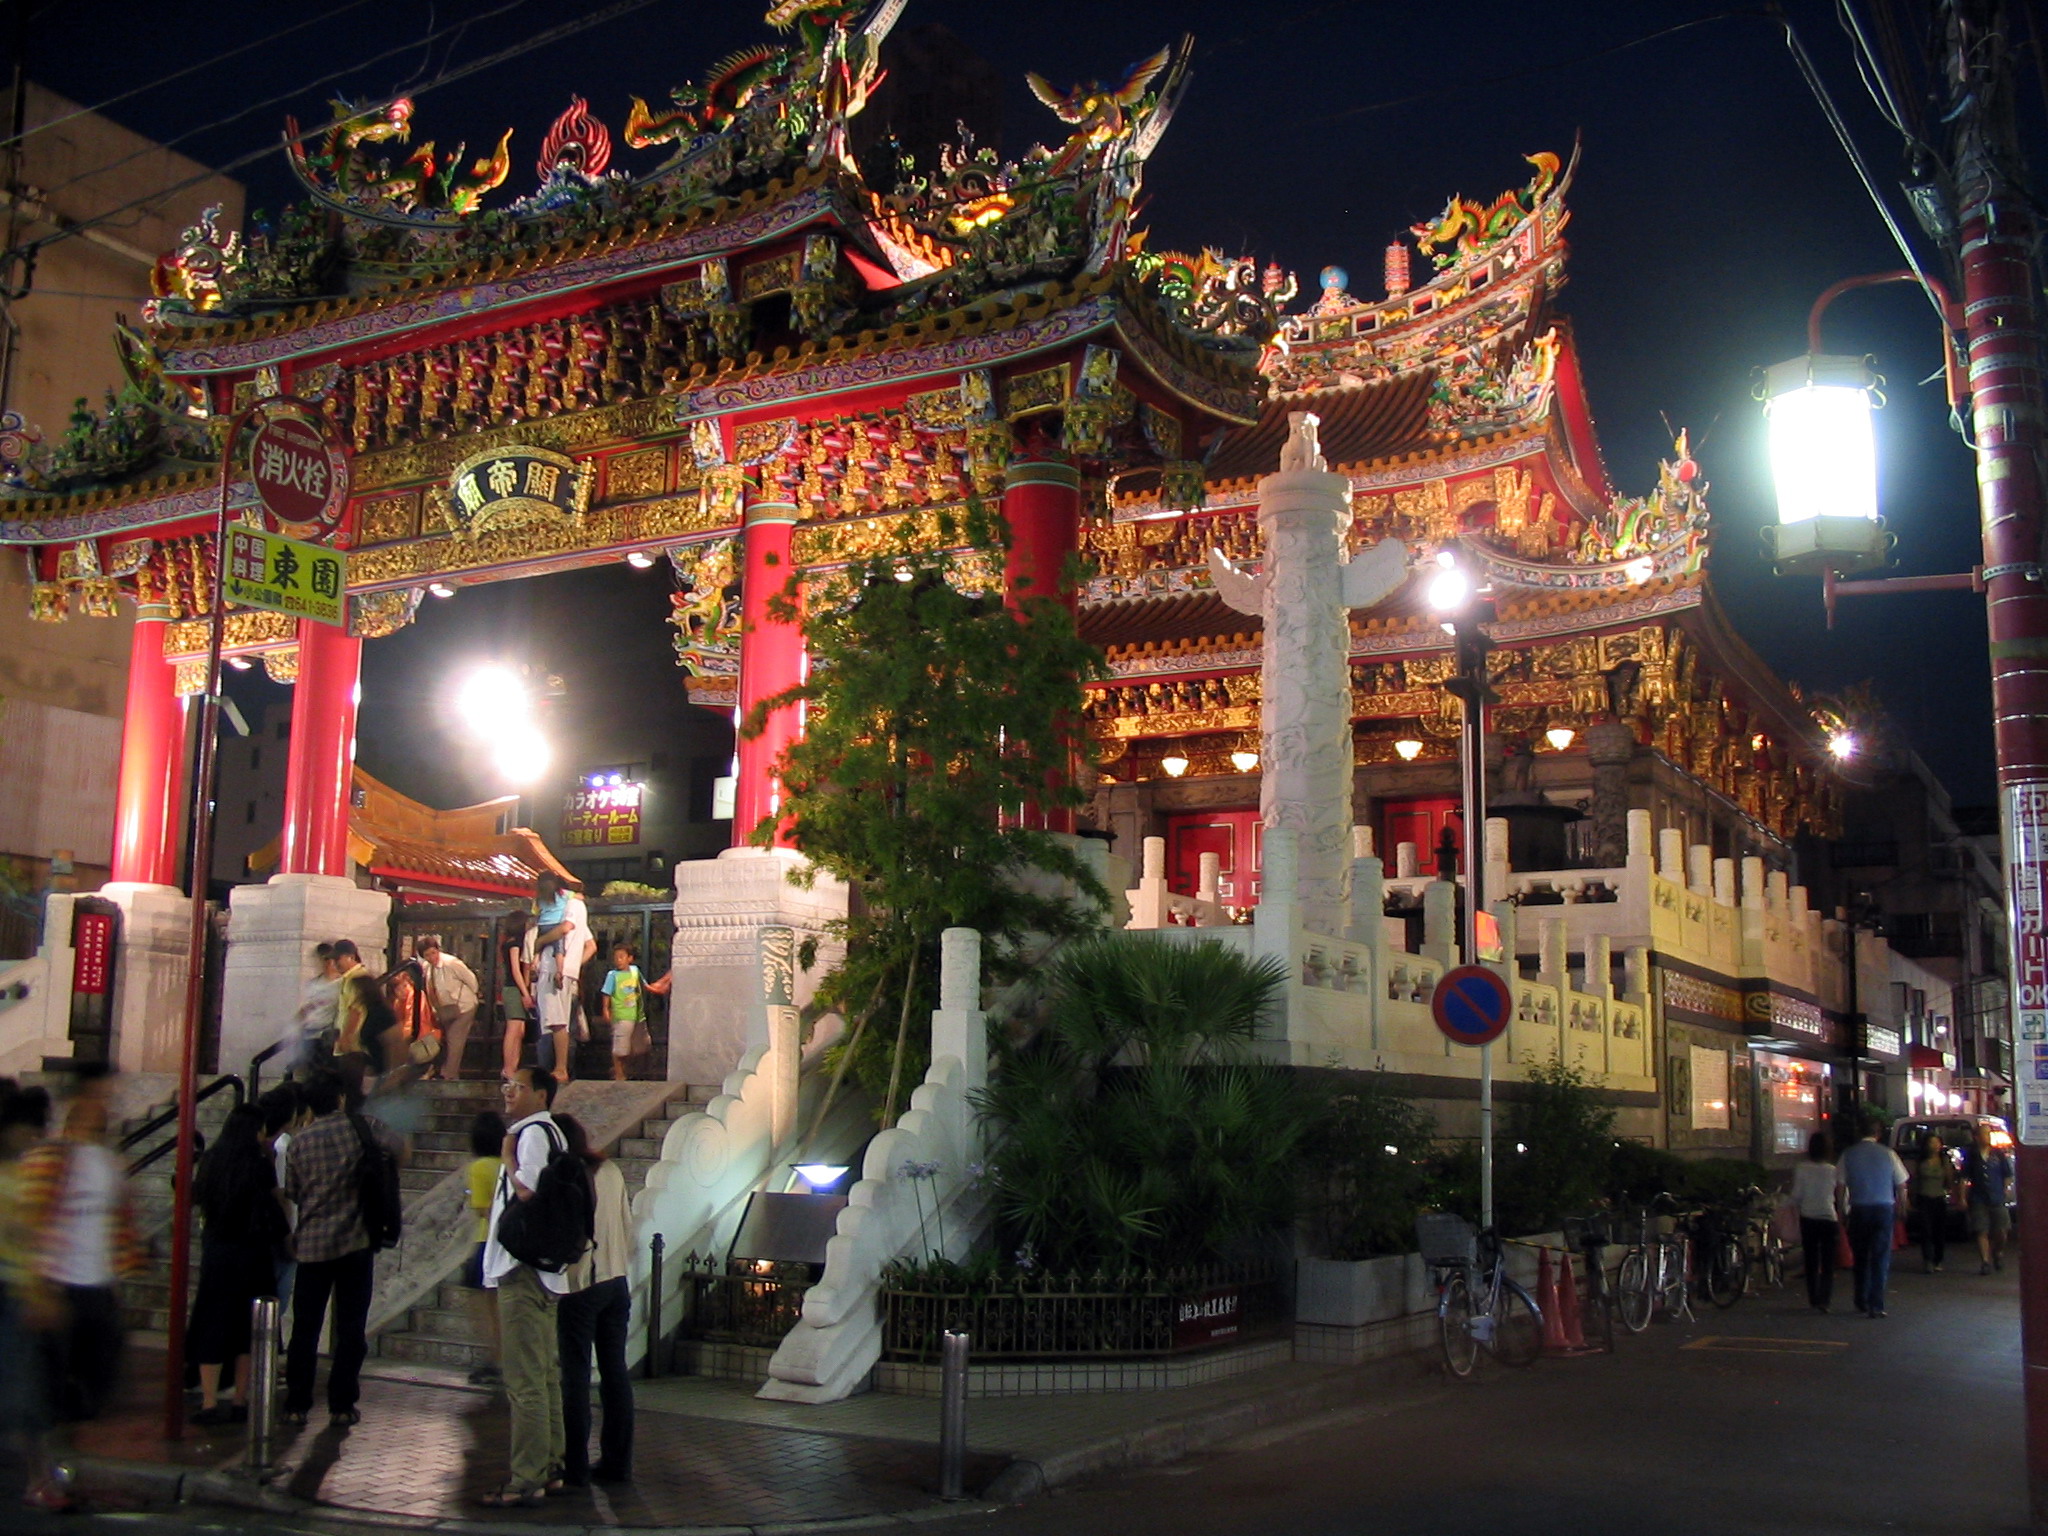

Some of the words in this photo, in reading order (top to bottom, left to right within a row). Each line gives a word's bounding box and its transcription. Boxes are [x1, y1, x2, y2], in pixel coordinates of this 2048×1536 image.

[259, 440, 328, 499] 消火栓
[233, 534, 266, 561] 中国
[231, 557, 266, 584] 料理
[270, 544, 340, 600] 東園
